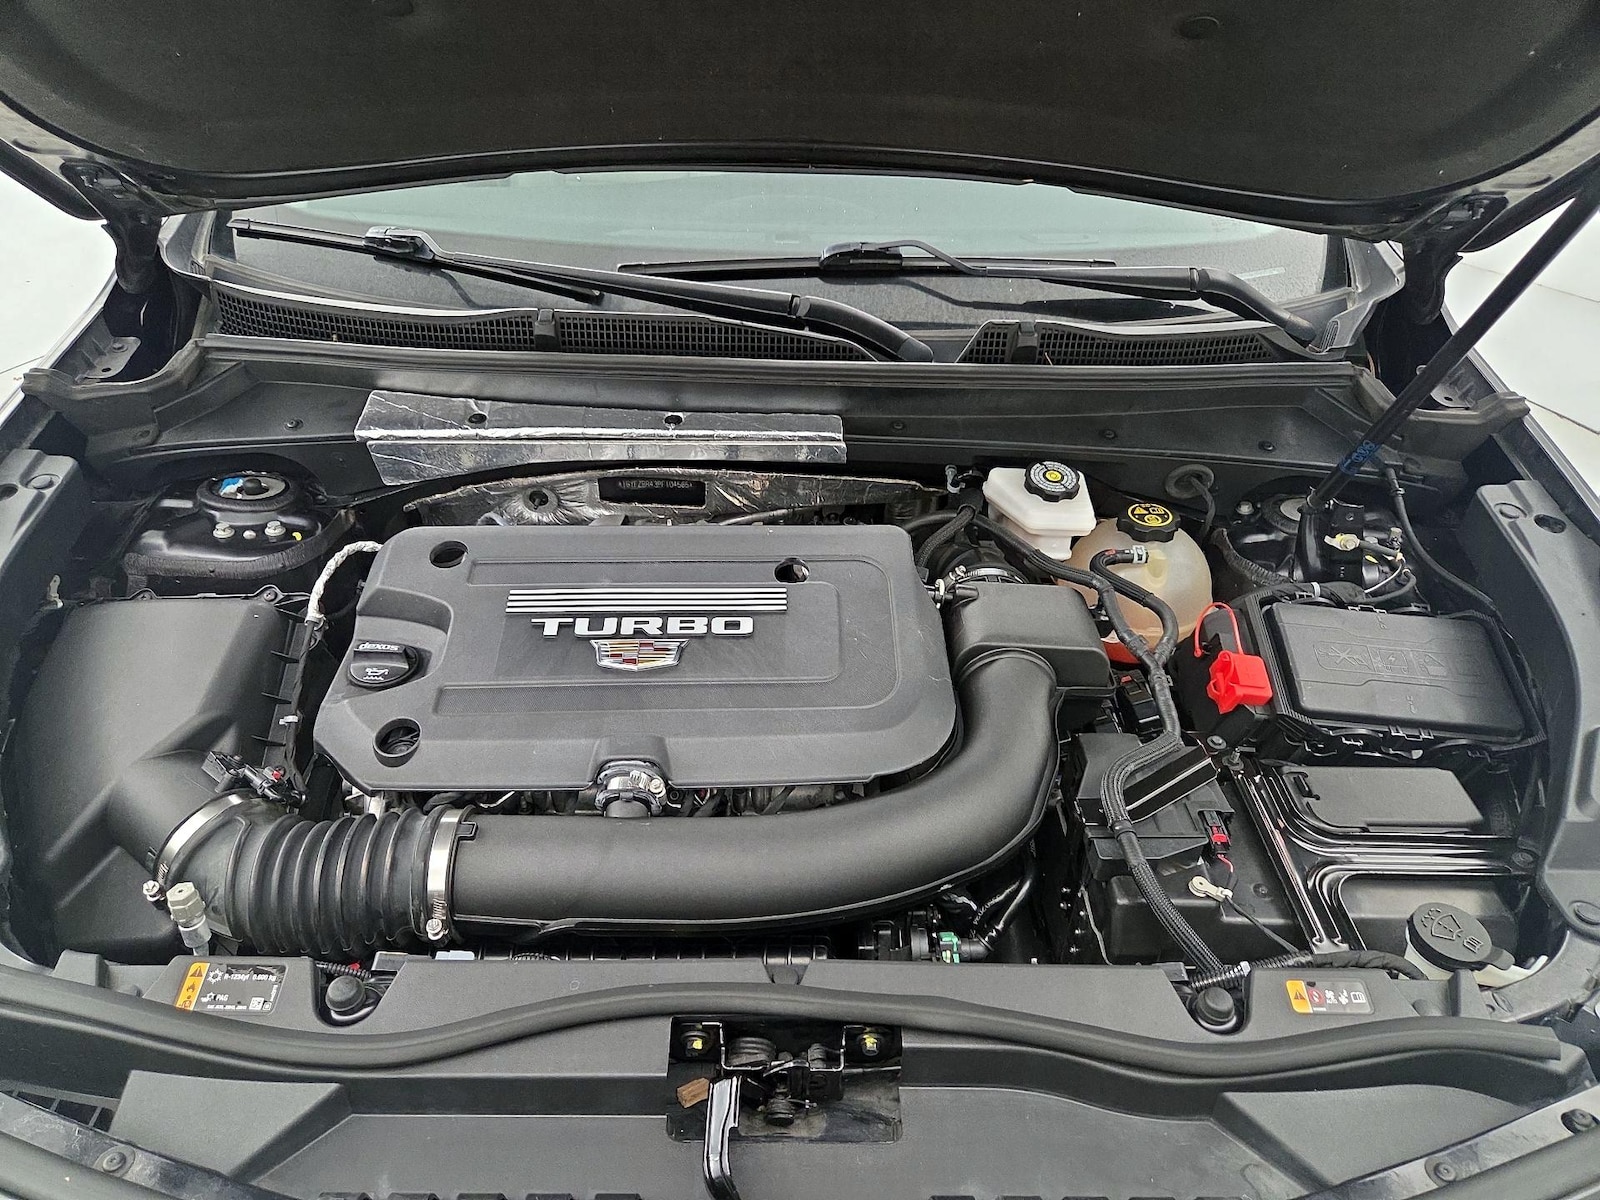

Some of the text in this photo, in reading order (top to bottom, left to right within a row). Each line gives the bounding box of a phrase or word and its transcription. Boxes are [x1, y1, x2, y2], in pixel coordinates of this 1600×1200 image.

[531, 616, 754, 637] TURBO
[359, 642, 400, 651] dexos
[216, 994, 229, 1002] PAG
